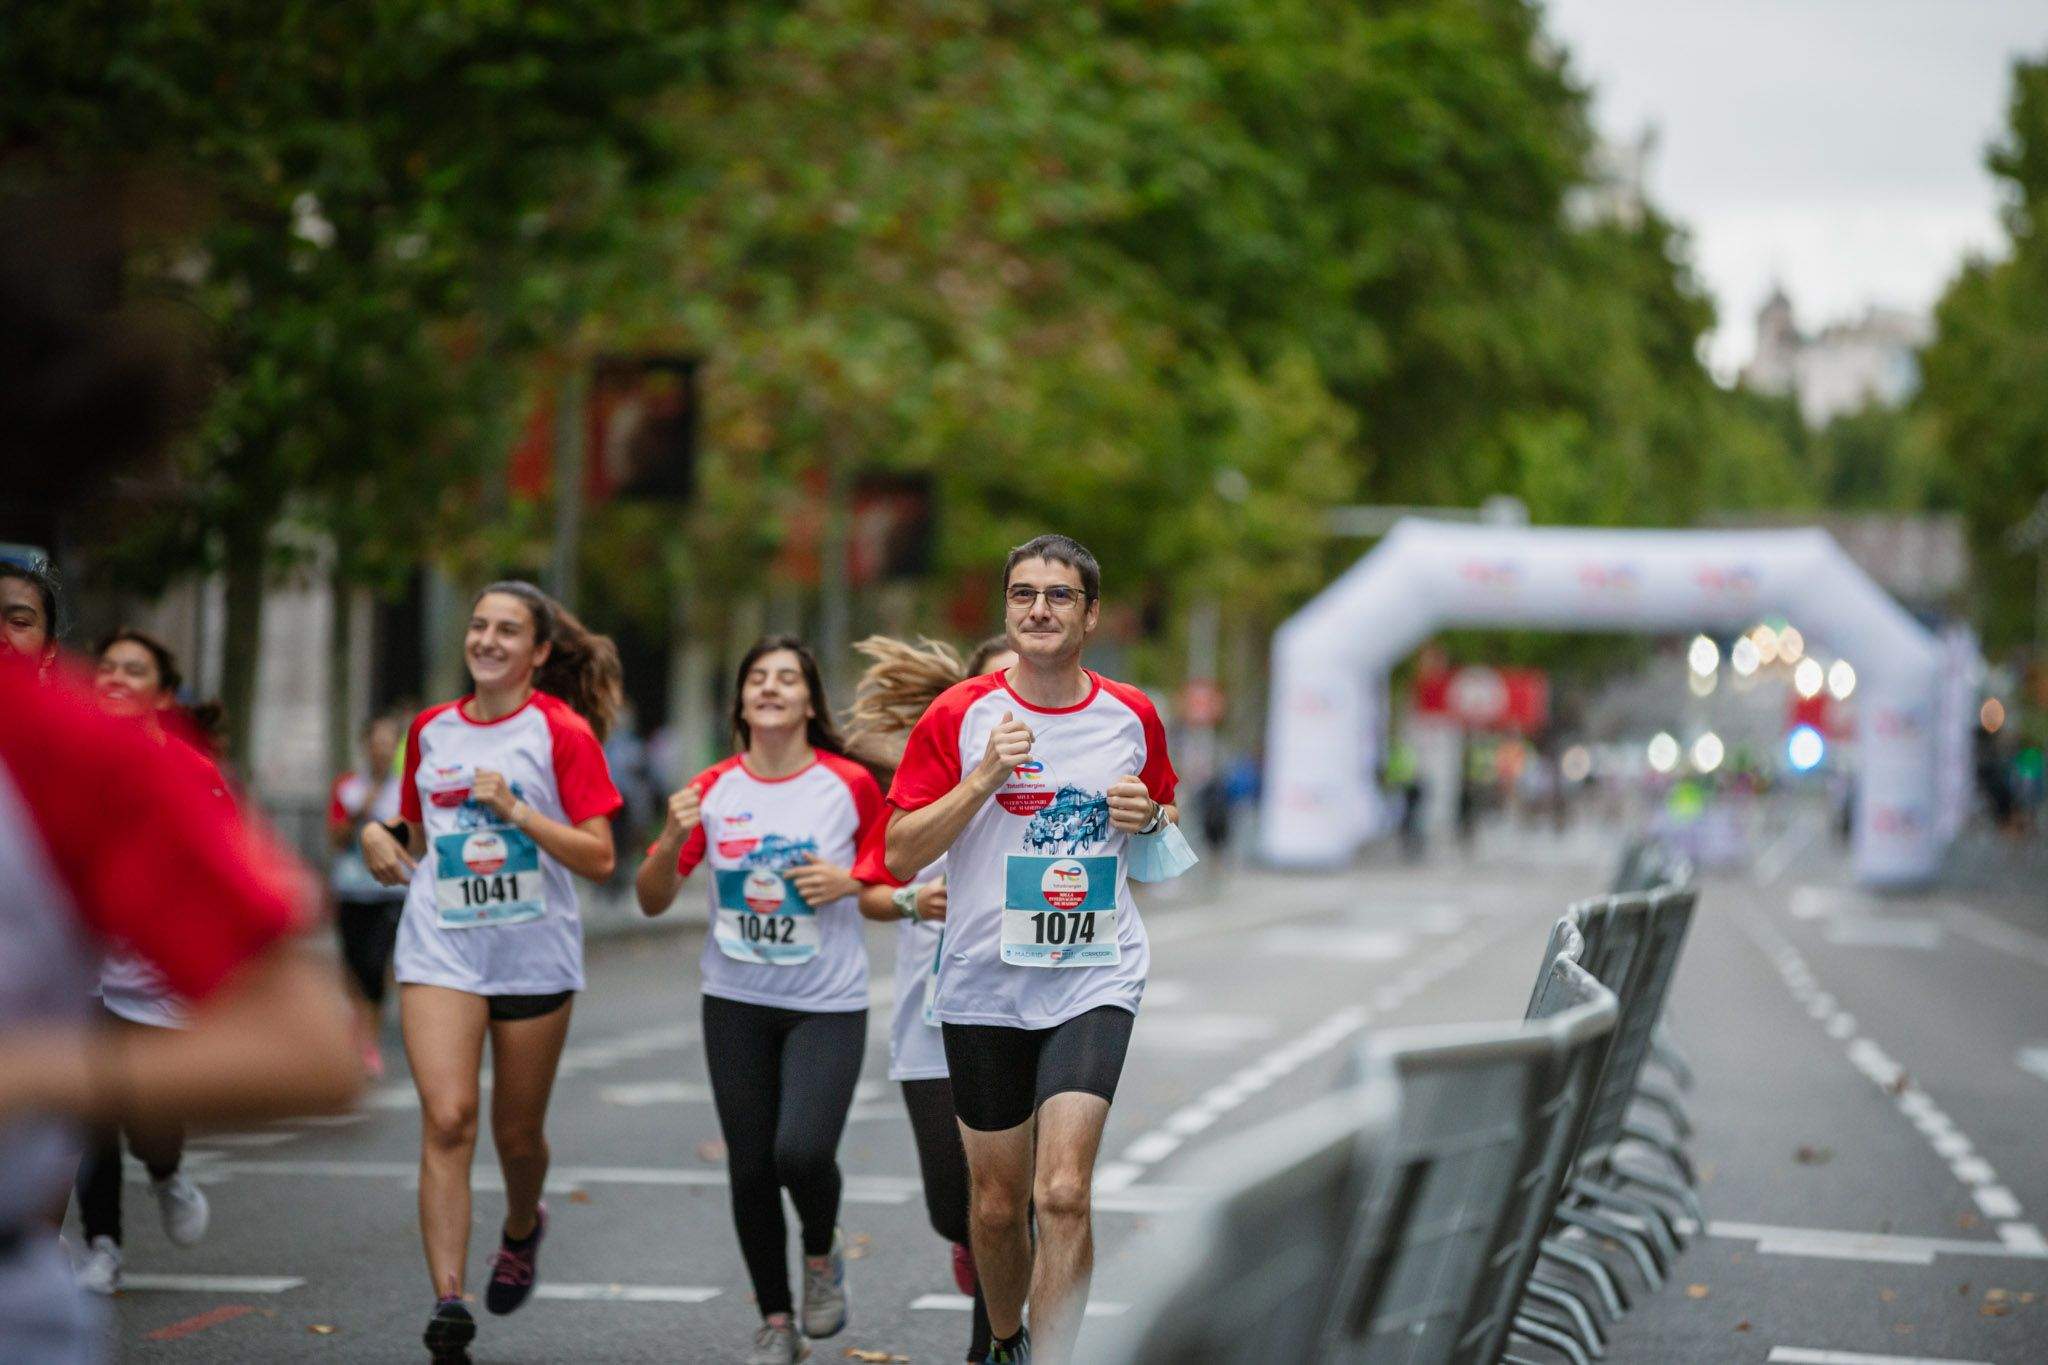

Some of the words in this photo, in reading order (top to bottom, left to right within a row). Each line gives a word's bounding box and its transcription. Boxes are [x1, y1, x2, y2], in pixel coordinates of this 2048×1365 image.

[460, 875, 519, 906] 1041
[737, 915, 795, 944] 1042
[1031, 912, 1095, 945] 1074
